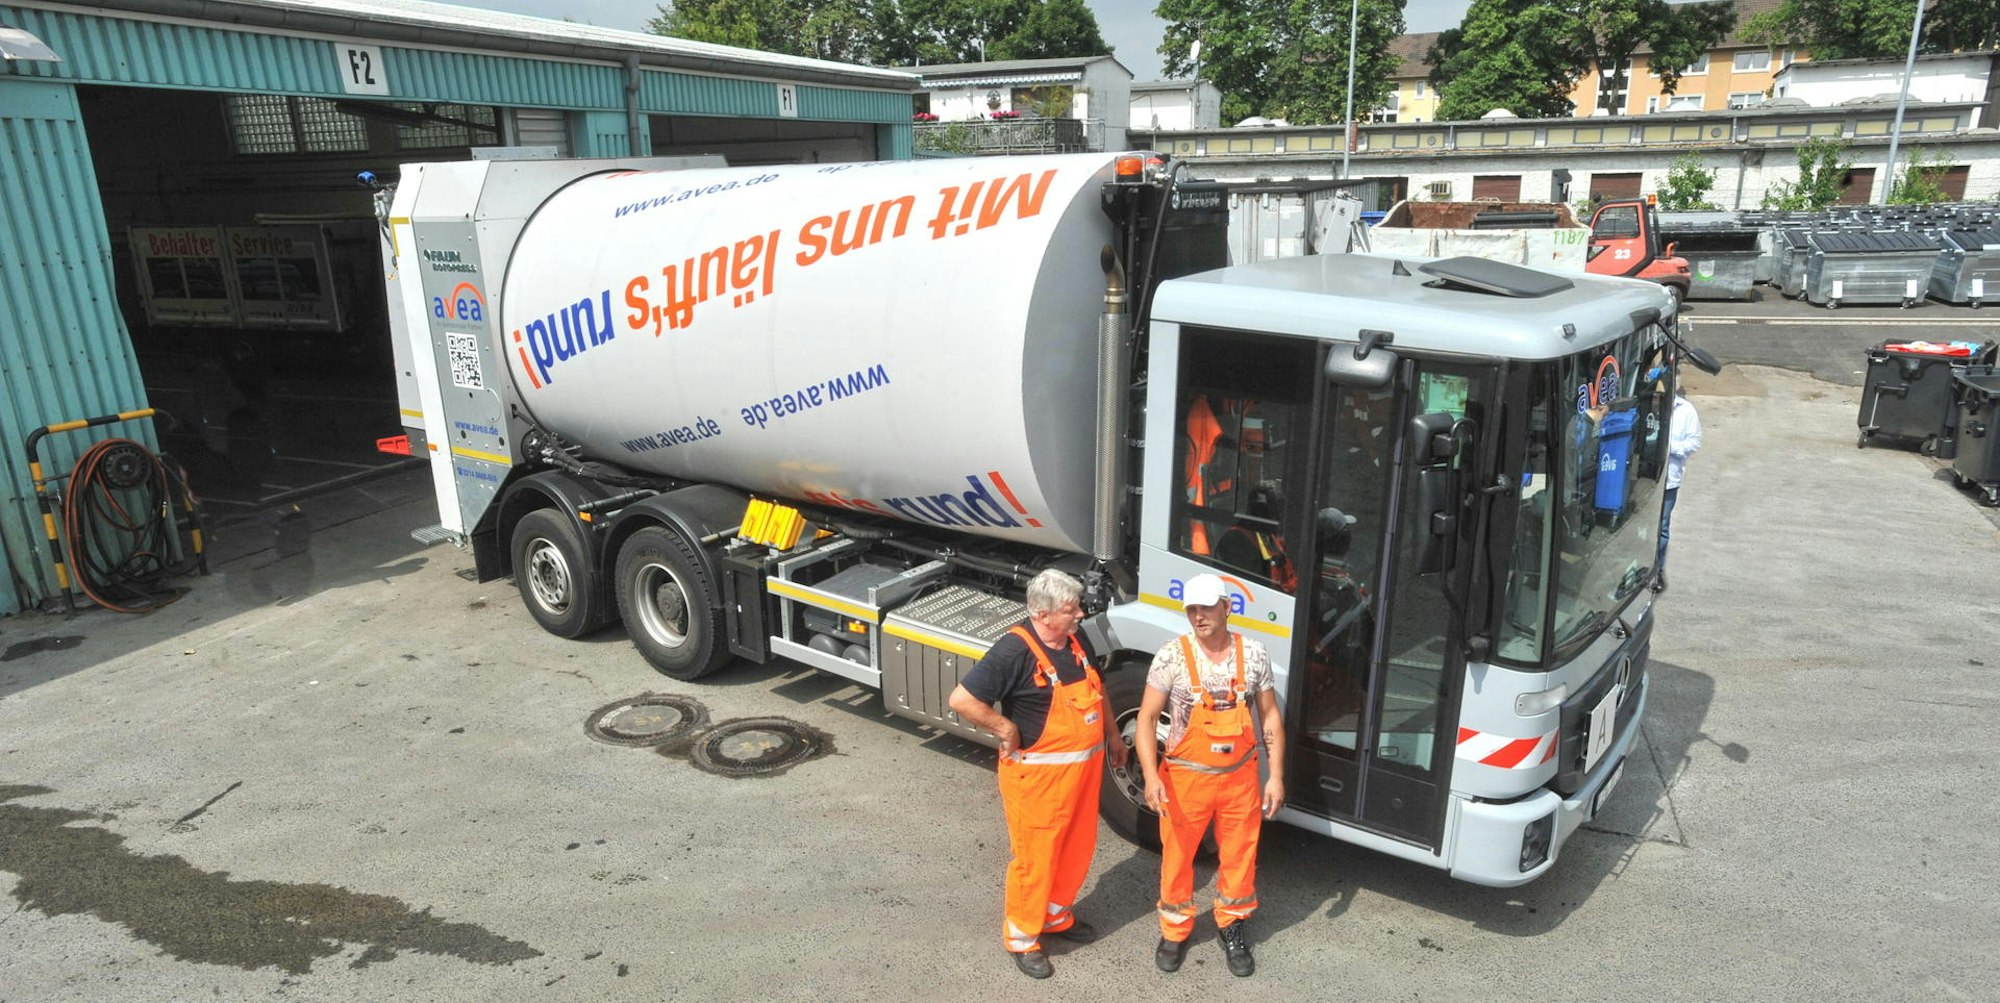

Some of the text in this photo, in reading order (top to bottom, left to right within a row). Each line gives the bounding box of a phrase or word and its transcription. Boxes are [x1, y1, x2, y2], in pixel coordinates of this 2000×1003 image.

[348, 49, 376, 85] F2
[782, 88, 792, 110] F1
[613, 171, 780, 219] www.avea.de
[148, 231, 294, 257] Behälter Service
[1614, 249, 1632, 260] 23
[513, 169, 1058, 389] Mit uns läuft's rund!
[434, 281, 485, 321] avea
[741, 363, 890, 430] www.avea.de
[1577, 354, 1621, 415] avea
[454, 420, 499, 436] www.avea.de
[620, 415, 722, 454] www.avea.de
[881, 470, 1044, 528] rund!
[1595, 707, 1606, 754] A
